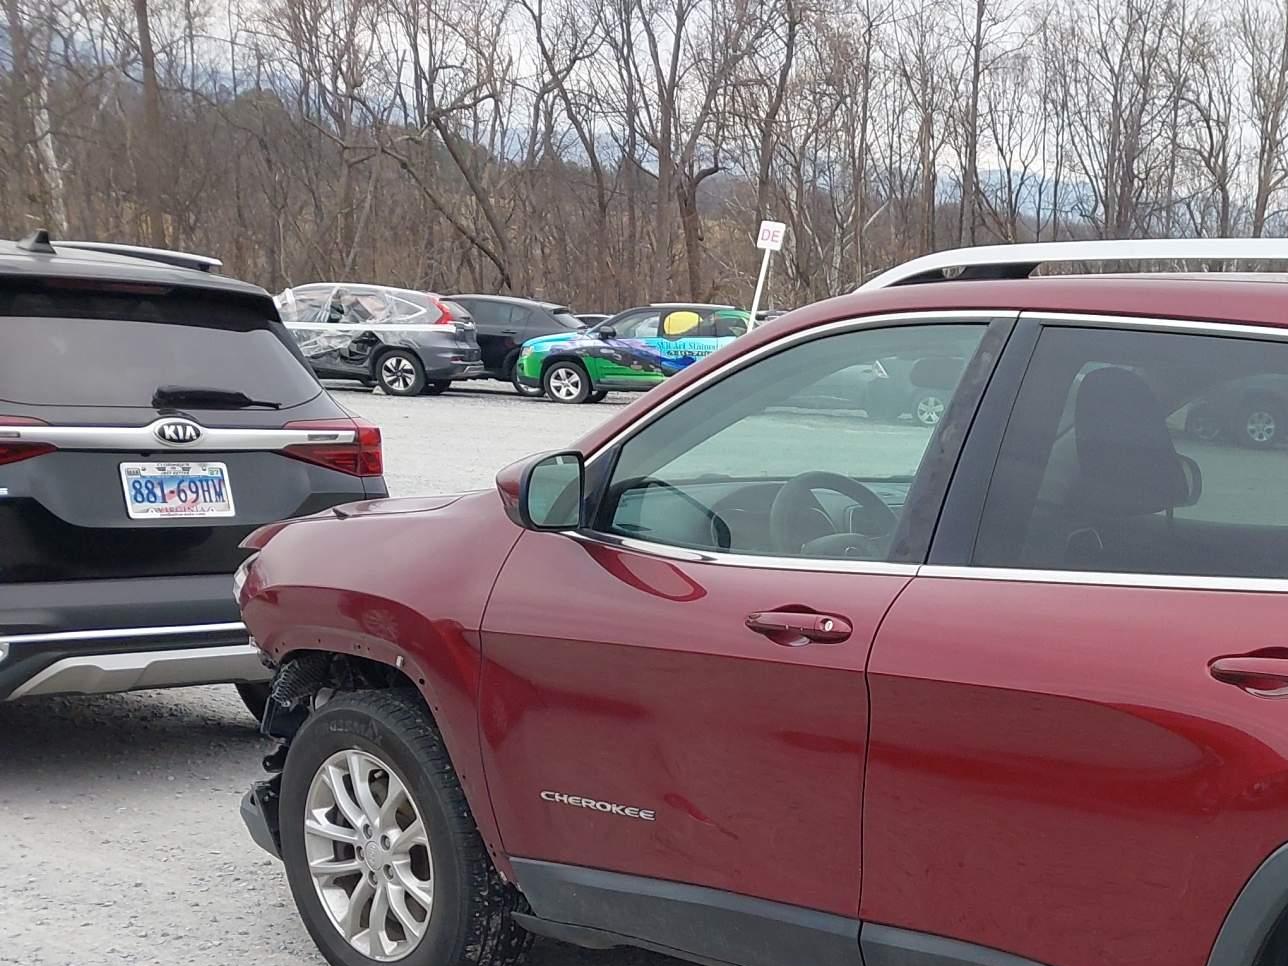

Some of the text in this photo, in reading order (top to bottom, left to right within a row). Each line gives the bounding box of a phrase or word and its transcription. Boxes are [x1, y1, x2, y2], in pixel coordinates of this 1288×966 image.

[760, 228, 781, 243] DE
[162, 424, 198, 441] KIA
[540, 790, 656, 821] CHEROKEE
